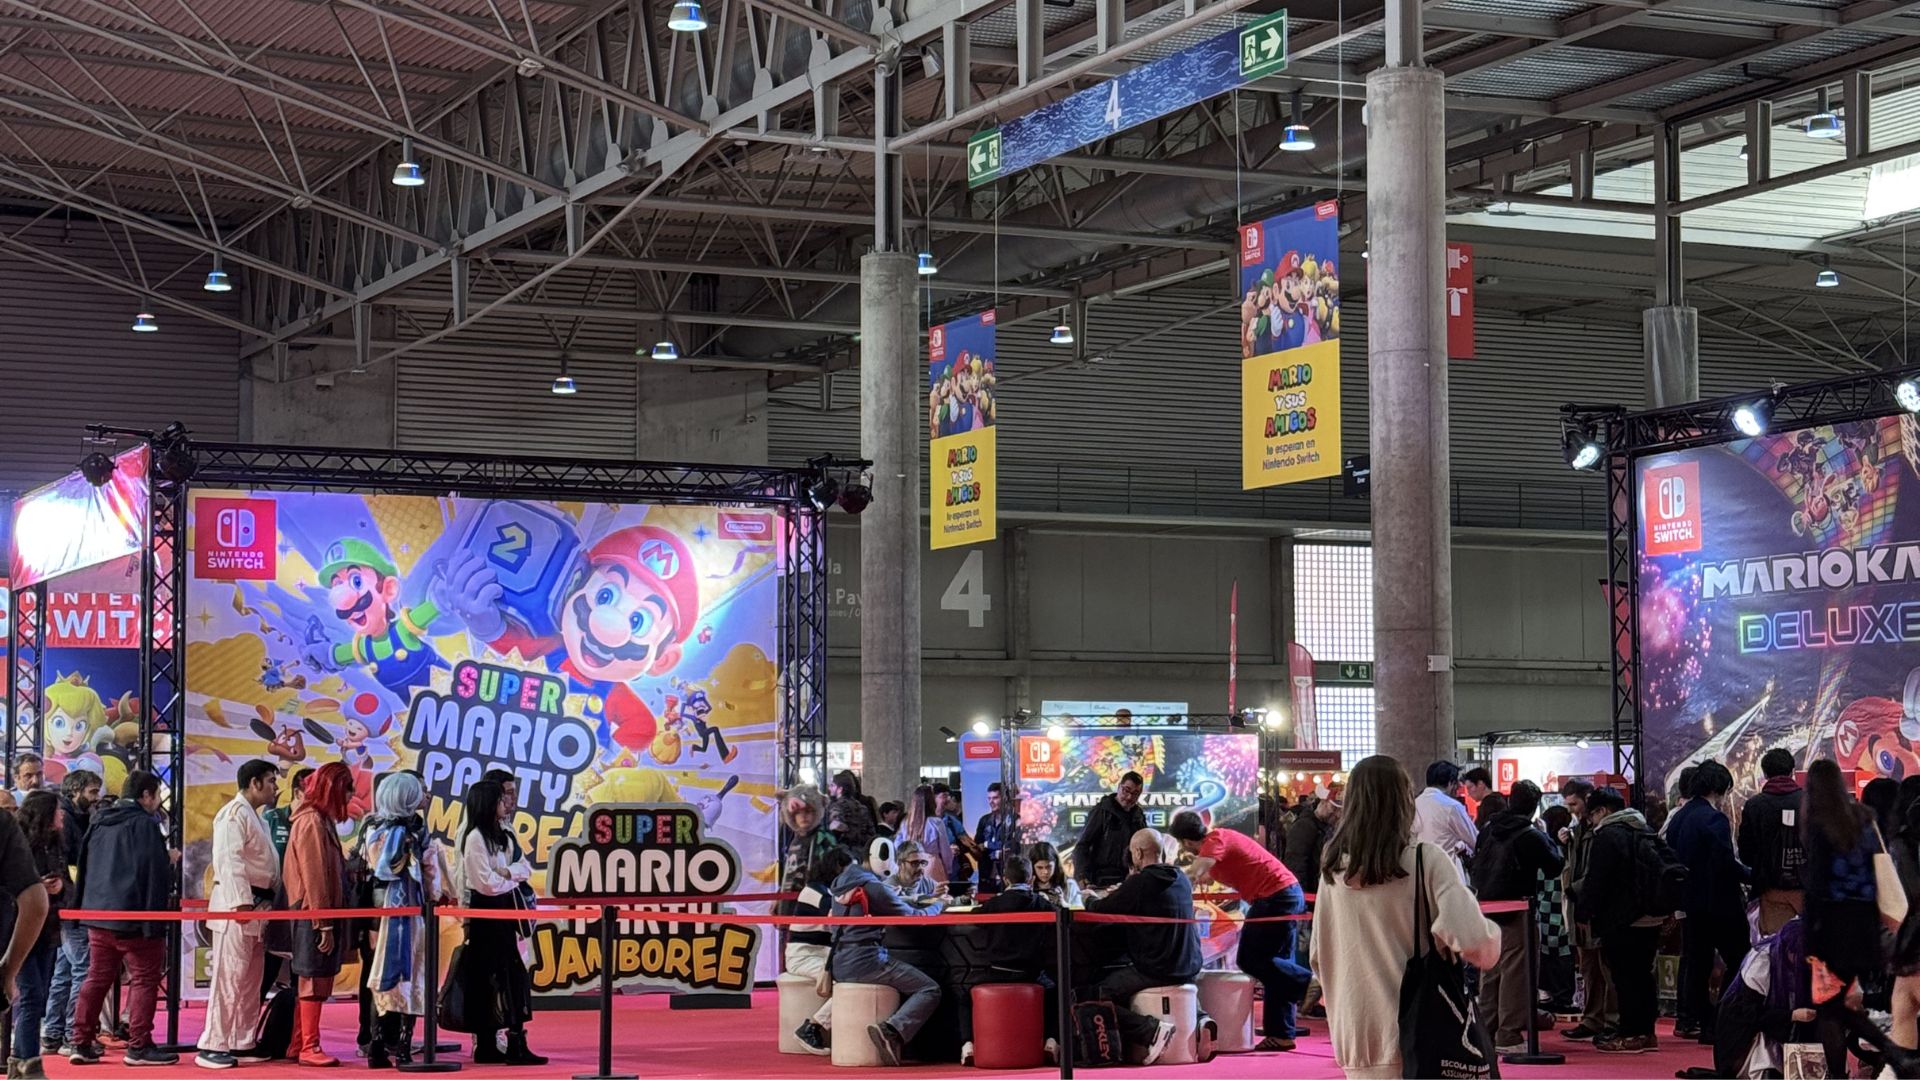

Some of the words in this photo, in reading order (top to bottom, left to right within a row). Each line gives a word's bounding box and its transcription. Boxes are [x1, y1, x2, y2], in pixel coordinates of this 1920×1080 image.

[1104, 79, 1122, 129] 4
[1268, 363, 1312, 392] MARIO
[1274, 395, 1285, 411] Y
[1285, 390, 1307, 409] SUS
[1264, 407, 1317, 438] AMIGOS
[947, 445, 977, 468] MARIO
[1275, 441, 1305, 455] esperan
[1306, 439, 1315, 449] en
[1263, 456, 1295, 470] Nintendo
[1296, 451, 1320, 465] Switch
[951, 471, 959, 485] Y
[959, 467, 973, 483] SUS
[946, 482, 981, 506] AMIGOS
[1653, 520, 1693, 532] NINTENDO
[1653, 528, 1694, 543] SWITCH
[207, 558, 265, 569] SWITCH
[940, 550, 991, 627] 4
[1739, 603, 1920, 654] DELUXE
[457, 665, 561, 714] SUPER
[409, 697, 590, 770] MARIO
[594, 814, 693, 844] SUPER
[558, 849, 730, 893] MARIO
